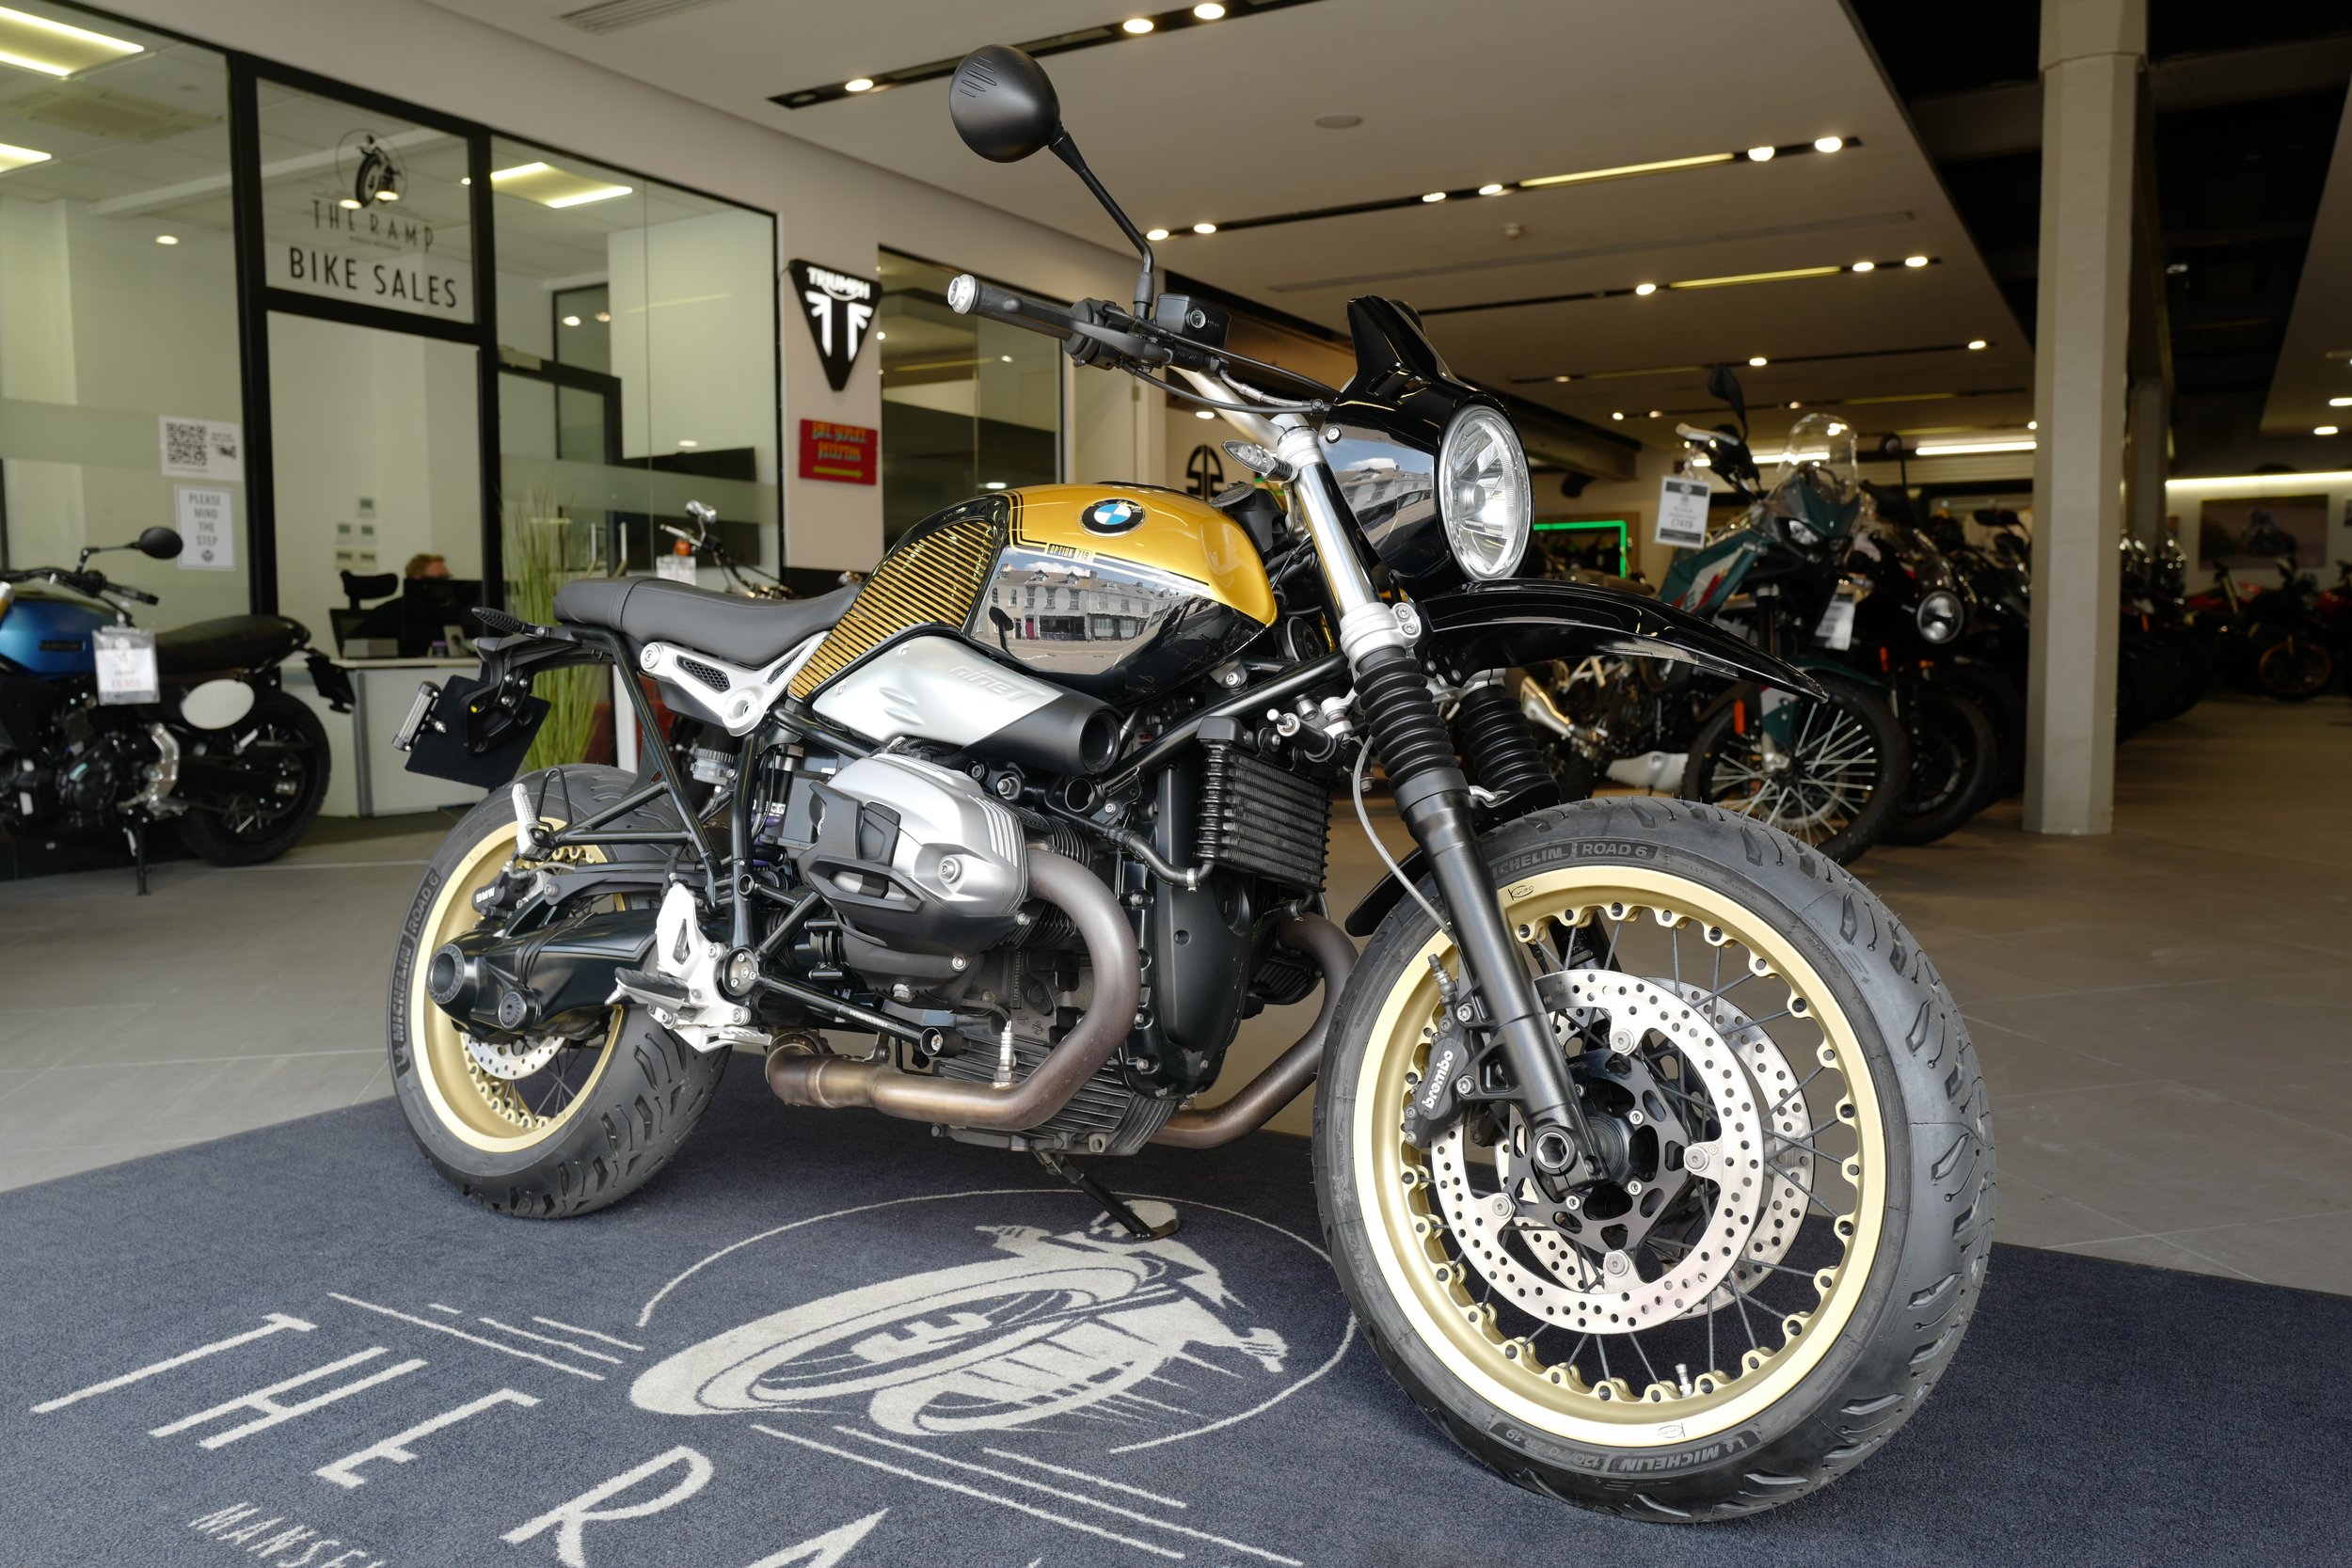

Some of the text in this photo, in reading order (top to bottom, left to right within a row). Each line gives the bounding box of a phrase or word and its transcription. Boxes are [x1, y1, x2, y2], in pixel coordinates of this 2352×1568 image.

[312, 199, 356, 231] THE
[370, 214, 434, 252] RAMP
[290, 245, 457, 309] BIKE SALES
[806, 265, 870, 300] TRIUMPH
[188, 493, 221, 507] PLEASE
[196, 535, 218, 546] STEP
[1049, 545, 1090, 562] OPTION 719
[1492, 842, 1648, 878] ICHELIN ROAD 6
[476, 886, 496, 904] BMW
[390, 873, 440, 1042] MICHELIN ROAD 6
[1422, 1050, 1454, 1110] brembo
[27, 1313, 543, 1489] THE
[1505, 1429, 1522, 1442] 19
[1549, 1446, 1600, 1468] 120/70
[1619, 1445, 1719, 1472] MICHELIN
[187, 1502, 387, 1568] MANS
